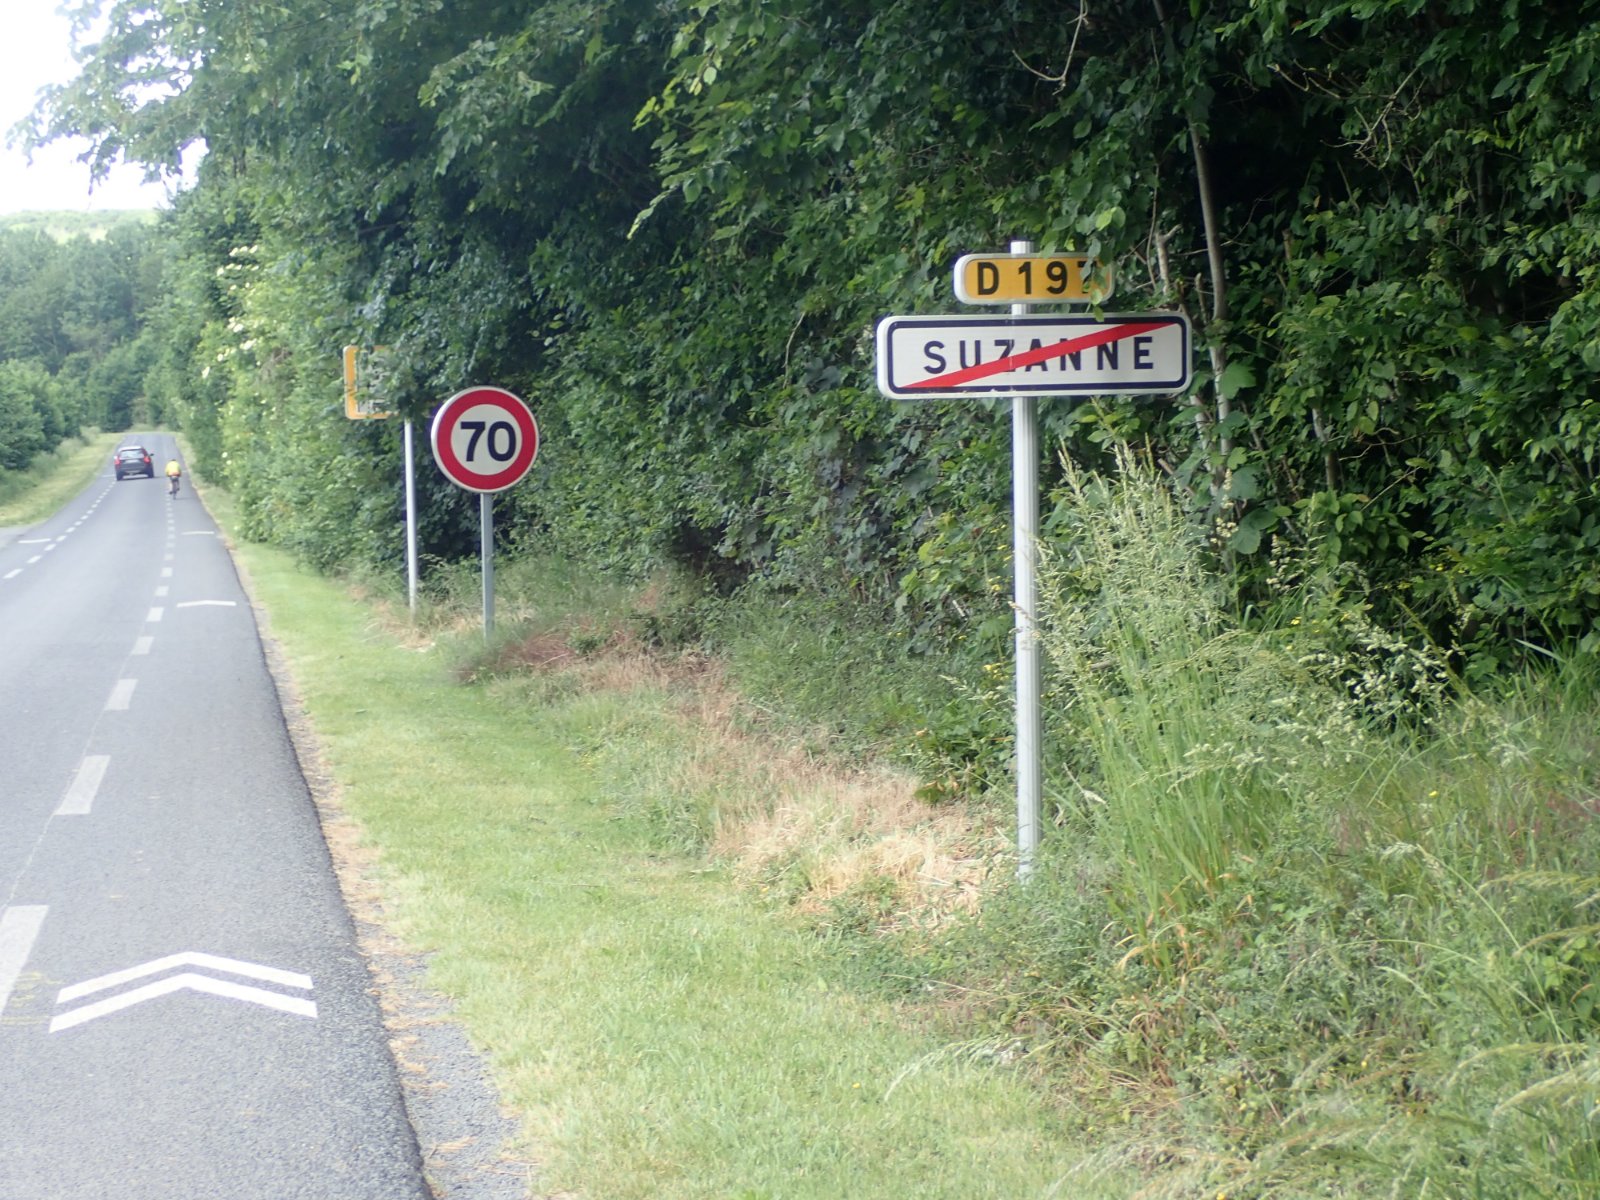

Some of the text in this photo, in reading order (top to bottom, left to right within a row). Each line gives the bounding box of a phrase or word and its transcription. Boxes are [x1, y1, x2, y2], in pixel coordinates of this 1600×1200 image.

[977, 261, 999, 295] D
[923, 336, 1154, 375] SUZANNE
[460, 420, 517, 462] 70
